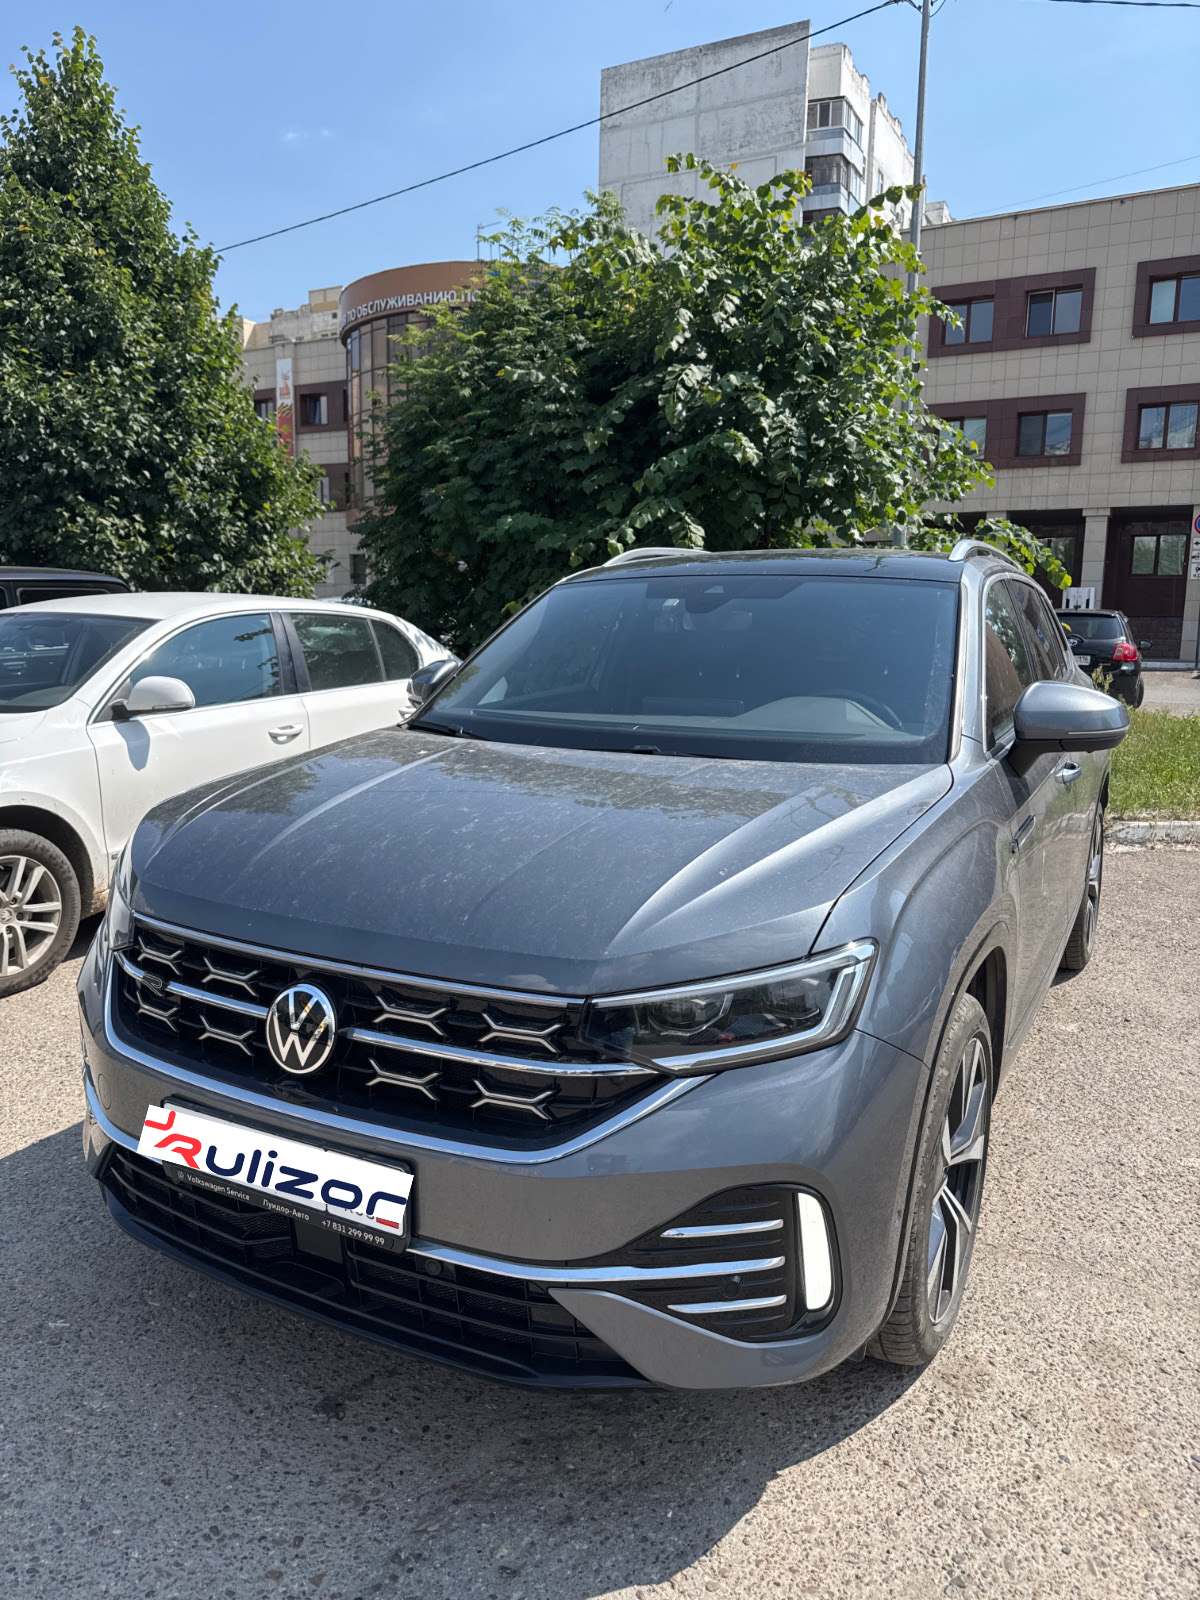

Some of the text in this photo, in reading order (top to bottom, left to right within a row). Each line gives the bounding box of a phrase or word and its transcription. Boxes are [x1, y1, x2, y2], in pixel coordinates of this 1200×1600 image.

[356, 290, 457, 317] ОБСЛУЖИВАНИЮ
[187, 1173, 250, 1201] Volkswagen Service
[321, 1220, 385, 1246] +7 831 299 99 99
